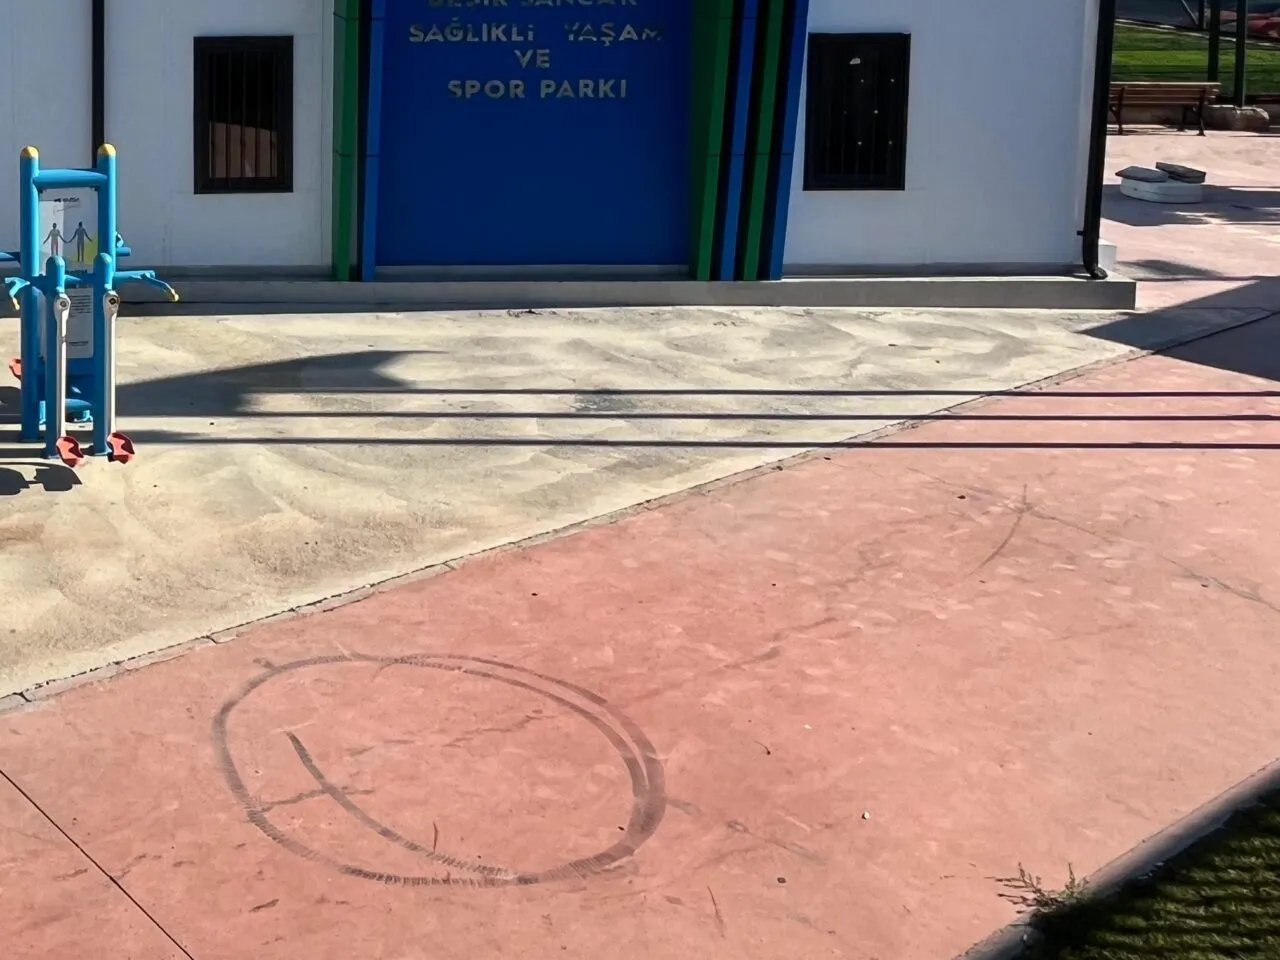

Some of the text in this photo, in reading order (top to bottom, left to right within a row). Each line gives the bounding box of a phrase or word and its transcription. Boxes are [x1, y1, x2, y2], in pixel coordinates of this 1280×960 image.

[514, 48, 551, 69] VE
[447, 78, 627, 99] SPOR PARKI
